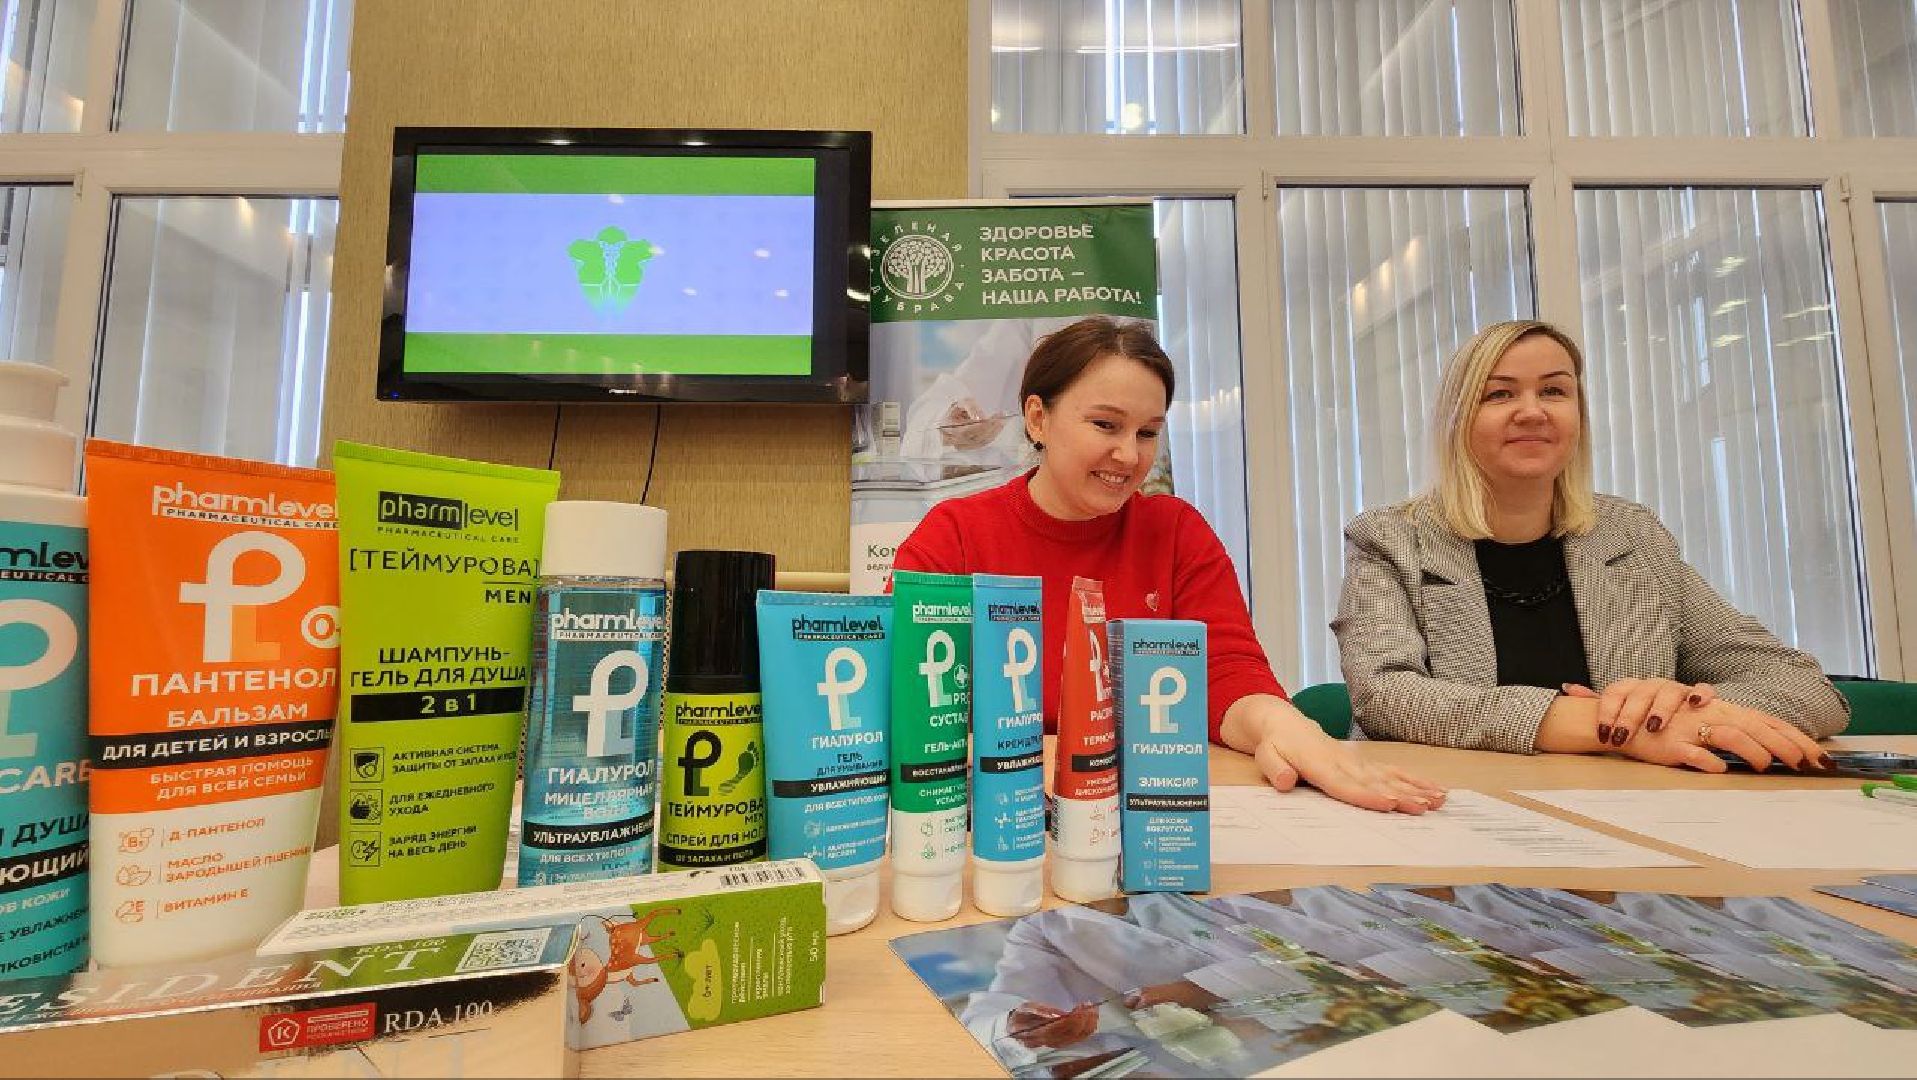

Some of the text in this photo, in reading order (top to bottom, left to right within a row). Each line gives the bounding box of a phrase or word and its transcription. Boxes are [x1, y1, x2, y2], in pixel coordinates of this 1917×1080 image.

[979, 224, 1094, 242] ЗДОРОВЬЕ
[981, 244, 1075, 262] КРАСОТА
[981, 268, 1065, 284] ЗАБОТА
[982, 286, 1142, 305] НАША РАБОТА!
[166, 508, 299, 528] PHARMACEUTICAL
[485, 589, 531, 604] MEN
[379, 646, 510, 664] ШАМПУНЬ-
[131, 667, 336, 697] ПАНТЕНОЛ
[350, 665, 526, 687] ГЕЛЬ ДЛЯ ДУША
[420, 695, 435, 714] 2
[466, 693, 476, 711] 1
[168, 703, 308, 728] БАЛЬЗАМ
[103, 744, 147, 761] ДЛЯ
[151, 735, 228, 758] ДЕТЕЙ
[234, 733, 249, 748] И
[812, 731, 884, 749] ГИАЛУРОЛ
[1132, 743, 1203, 755] ГИАЛУРОЛ
[392, 743, 499, 761] АКТИВНАЯ СИСТЕМА
[837, 752, 863, 763] ГЕЛЬ
[150, 757, 313, 784] БЫСТРАЯ ПОМОЩЬ
[392, 761, 441, 774] ЗАЩИТЫ
[444, 759, 457, 768] ОТ
[548, 762, 654, 784] ГИАЛУРОЛ
[156, 771, 306, 801] ДЛЯ ВСЕЙ СЕМЬИ
[1139, 777, 1199, 788] ЭЛИКСИР
[389, 782, 494, 806] ДЛЯ ЕЖЕДНЕВНОГО
[389, 805, 429, 816] УХОДА
[389, 825, 477, 844] ЗАРЯД ЭНЕРГИИ
[666, 832, 707, 847] СПРЕЙ
[709, 833, 740, 848] ДЛЯ
[389, 839, 468, 858] НА ВЕСЬ ДЕНЬ
[563, 852, 594, 863] ВСЕХ
[166, 857, 261, 883] ЗАРОДЫШЕЙ
[168, 853, 224, 869] МАСЛО
[164, 891, 237, 913] ВИТАМИН
[384, 1007, 444, 1035] RDA
[454, 999, 494, 1024] 100
